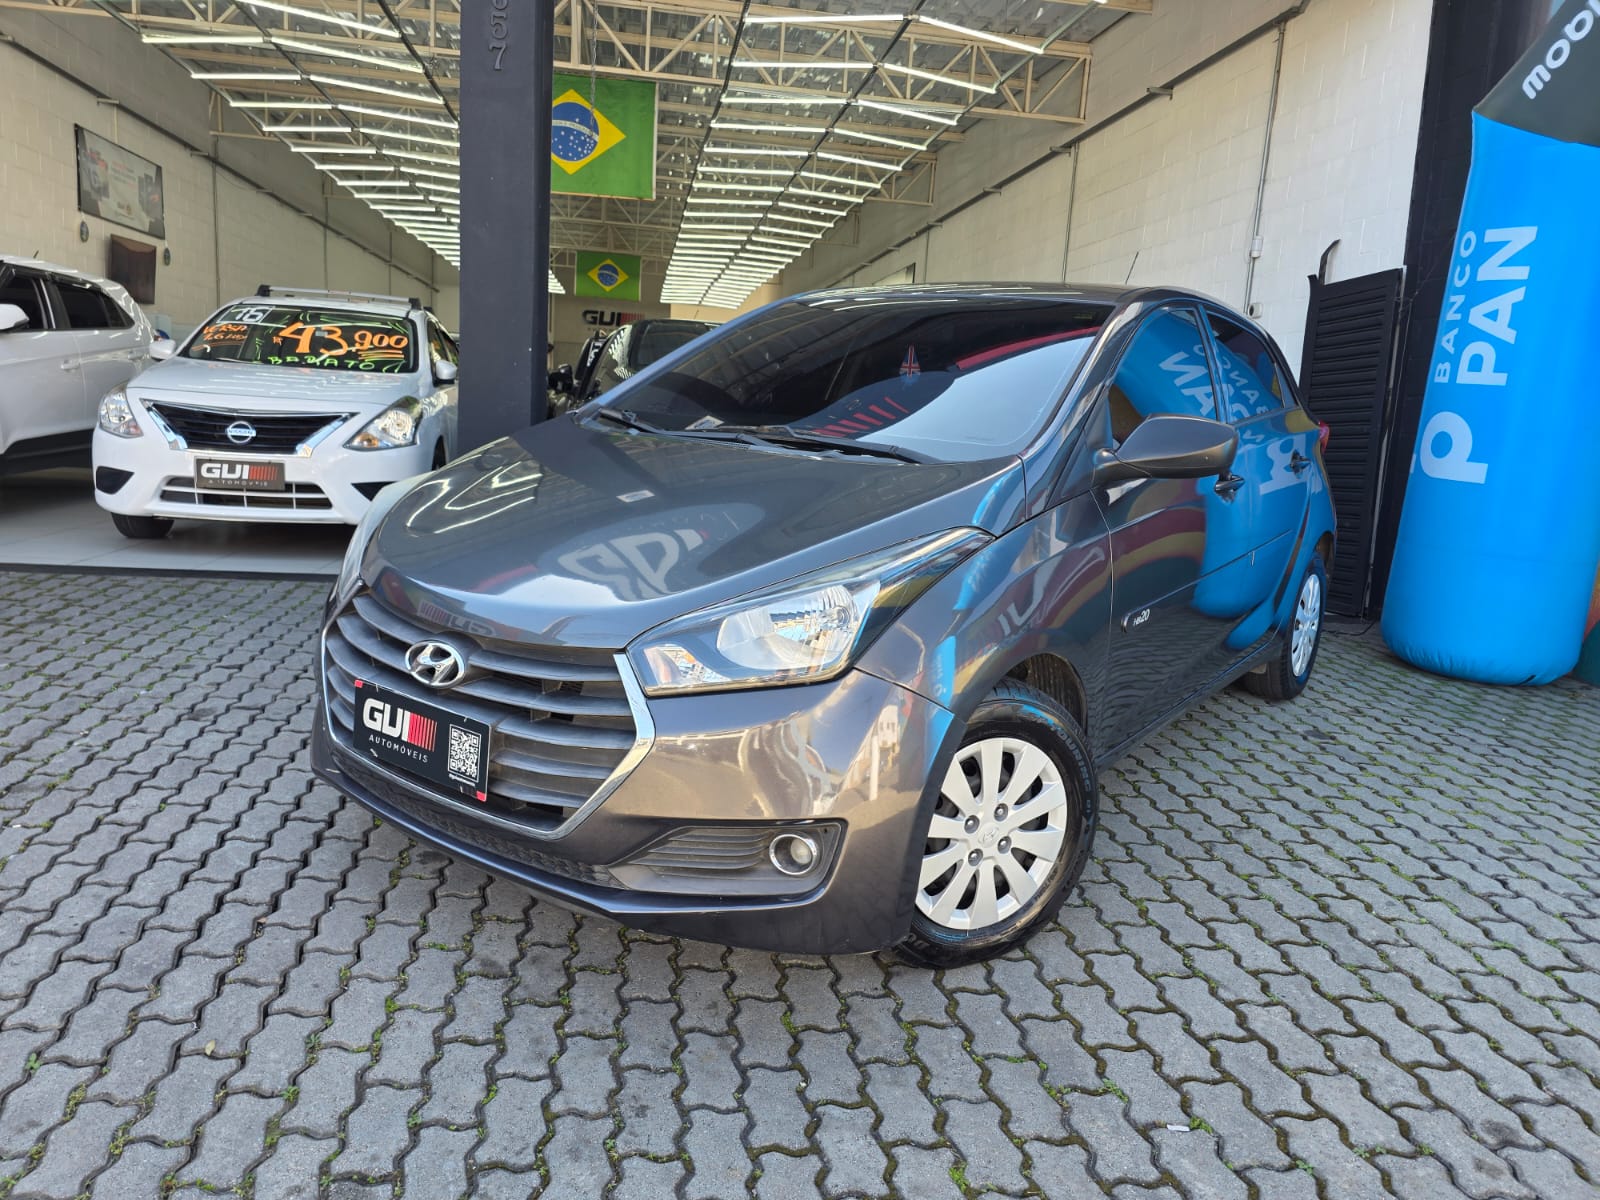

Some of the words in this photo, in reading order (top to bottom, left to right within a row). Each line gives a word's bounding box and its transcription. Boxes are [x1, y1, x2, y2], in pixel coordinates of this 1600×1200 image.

[582, 310, 622, 326] GUI
[1434, 230, 1477, 384] BANCO
[1455, 226, 1538, 386] PAN
[201, 463, 250, 480] GUI
[363, 698, 411, 742] GUI
[368, 734, 429, 763] AUTOMÓVEIS
